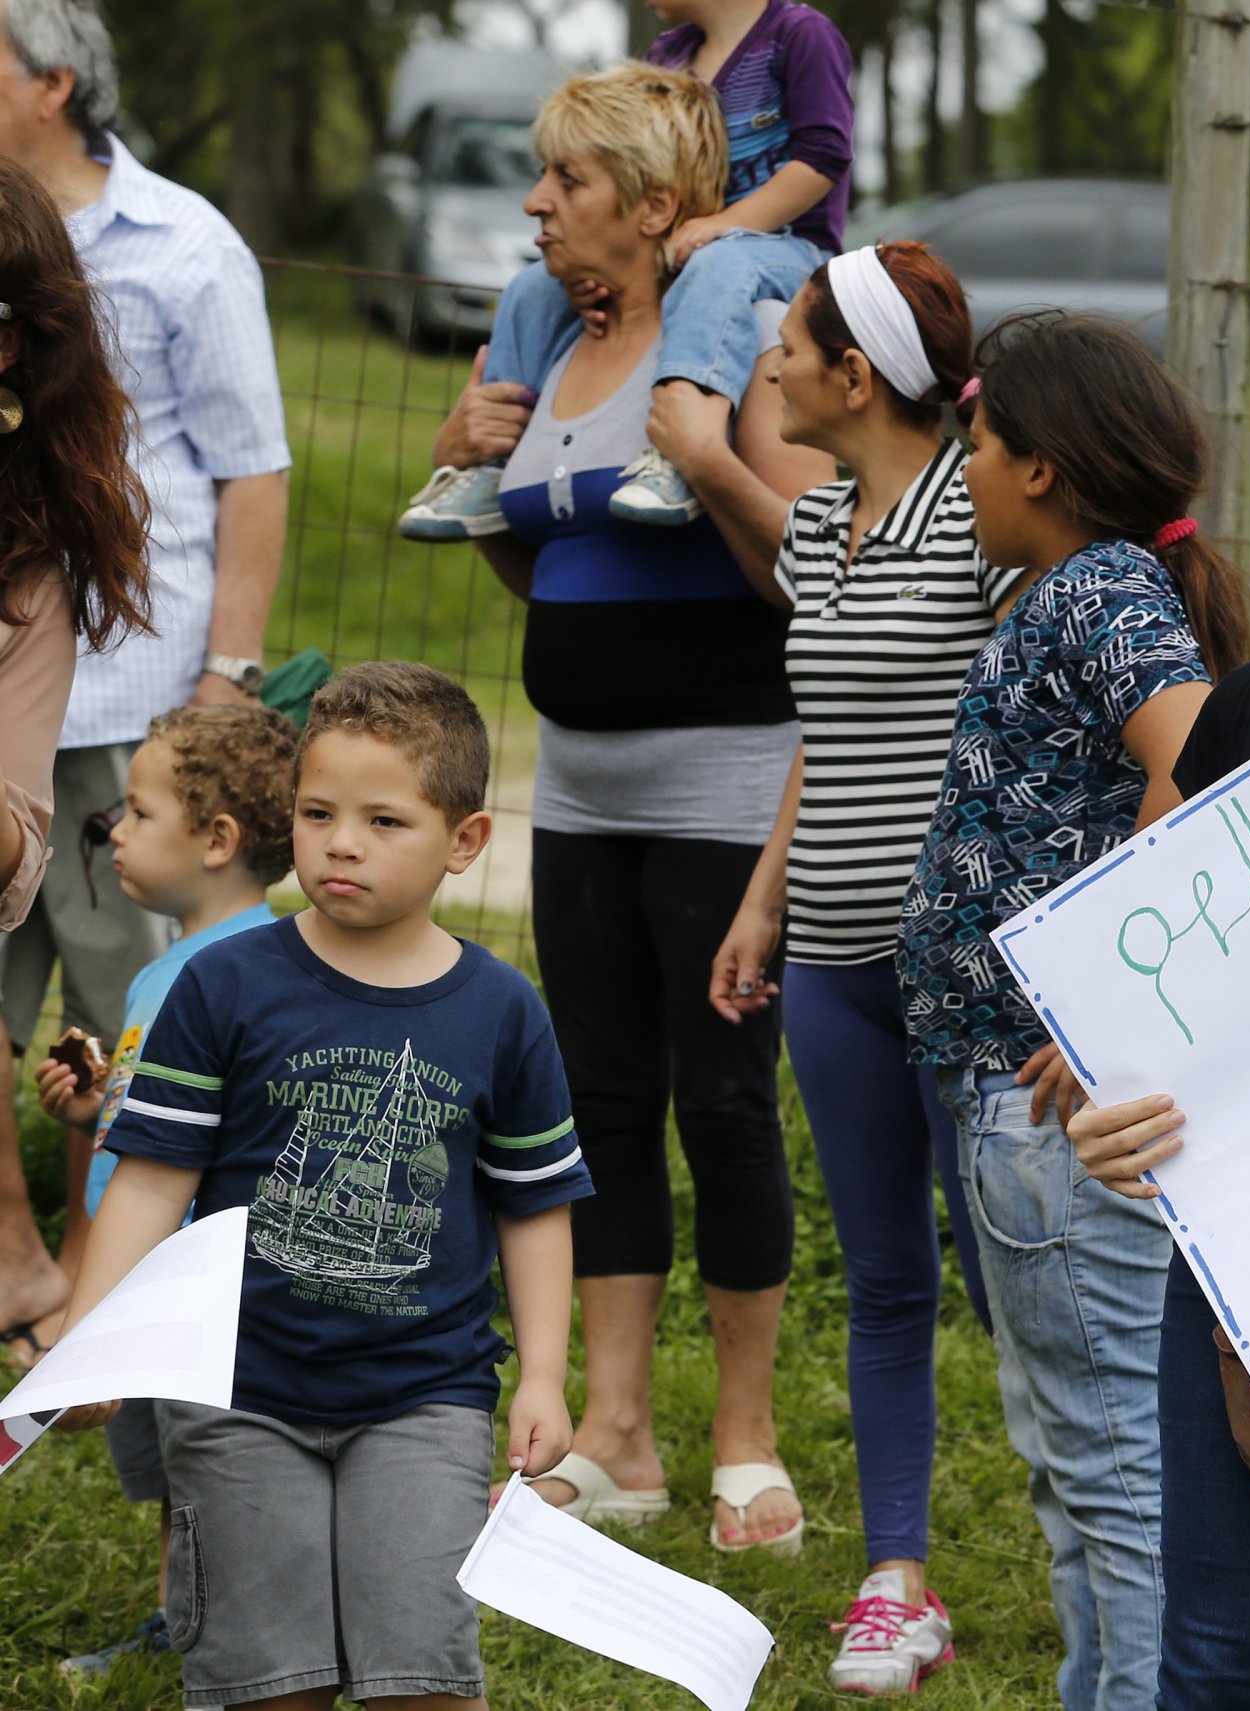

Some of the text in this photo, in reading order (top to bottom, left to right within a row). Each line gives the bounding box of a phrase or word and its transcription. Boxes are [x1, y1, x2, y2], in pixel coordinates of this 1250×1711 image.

[285, 1047, 464, 1098] YACHTING UNION
[330, 1065, 382, 1090] Sailing
[266, 1080, 471, 1131] MARINE CORPS
[297, 1110, 438, 1146] PORTLAND CITY
[304, 1130, 362, 1155] Ocean
[412, 1170, 437, 1184] Since
[256, 1175, 443, 1230] NAUTICAL ADVENTURE
[361, 1228, 375, 1239] OF
[319, 1243, 348, 1258] PRIZE
[351, 1249, 365, 1261] OF
[366, 1252, 391, 1265] GOLD
[289, 1286, 429, 1317] KNOW TO MASTER THE NATURE
[291, 1277, 324, 1293] THOSE
[325, 1284, 346, 1298] ARE
[348, 1289, 368, 1302] THE
[369, 1292, 393, 1304] ONES
